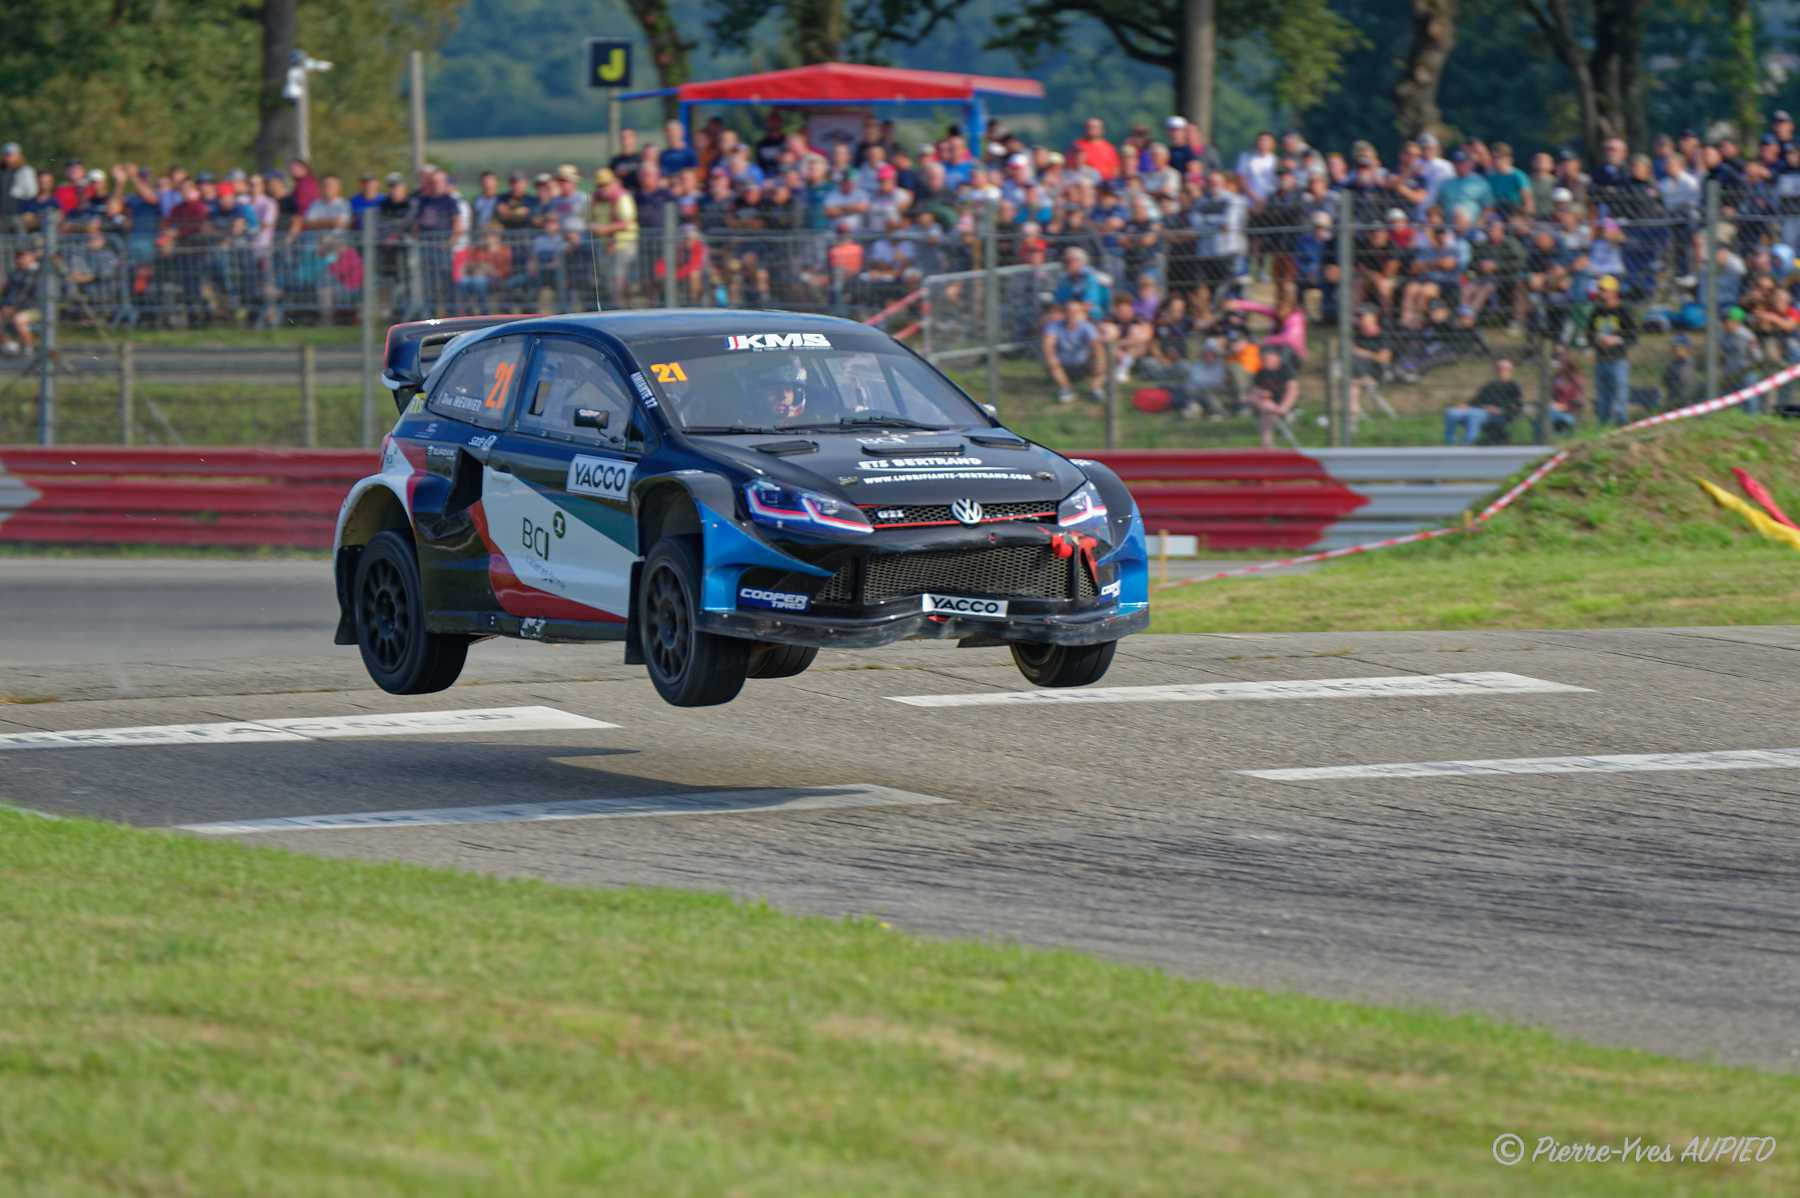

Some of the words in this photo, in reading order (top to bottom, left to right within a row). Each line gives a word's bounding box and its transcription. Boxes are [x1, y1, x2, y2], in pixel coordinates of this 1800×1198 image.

[597, 48, 626, 82] J
[733, 333, 832, 350] KMS
[650, 361, 689, 383] 21
[484, 361, 517, 411] 21
[891, 457, 982, 467] BERTRAND
[575, 463, 627, 492] YACCO
[522, 517, 549, 561] BCI
[740, 588, 808, 603] COOPER
[930, 596, 999, 614] YACCO
